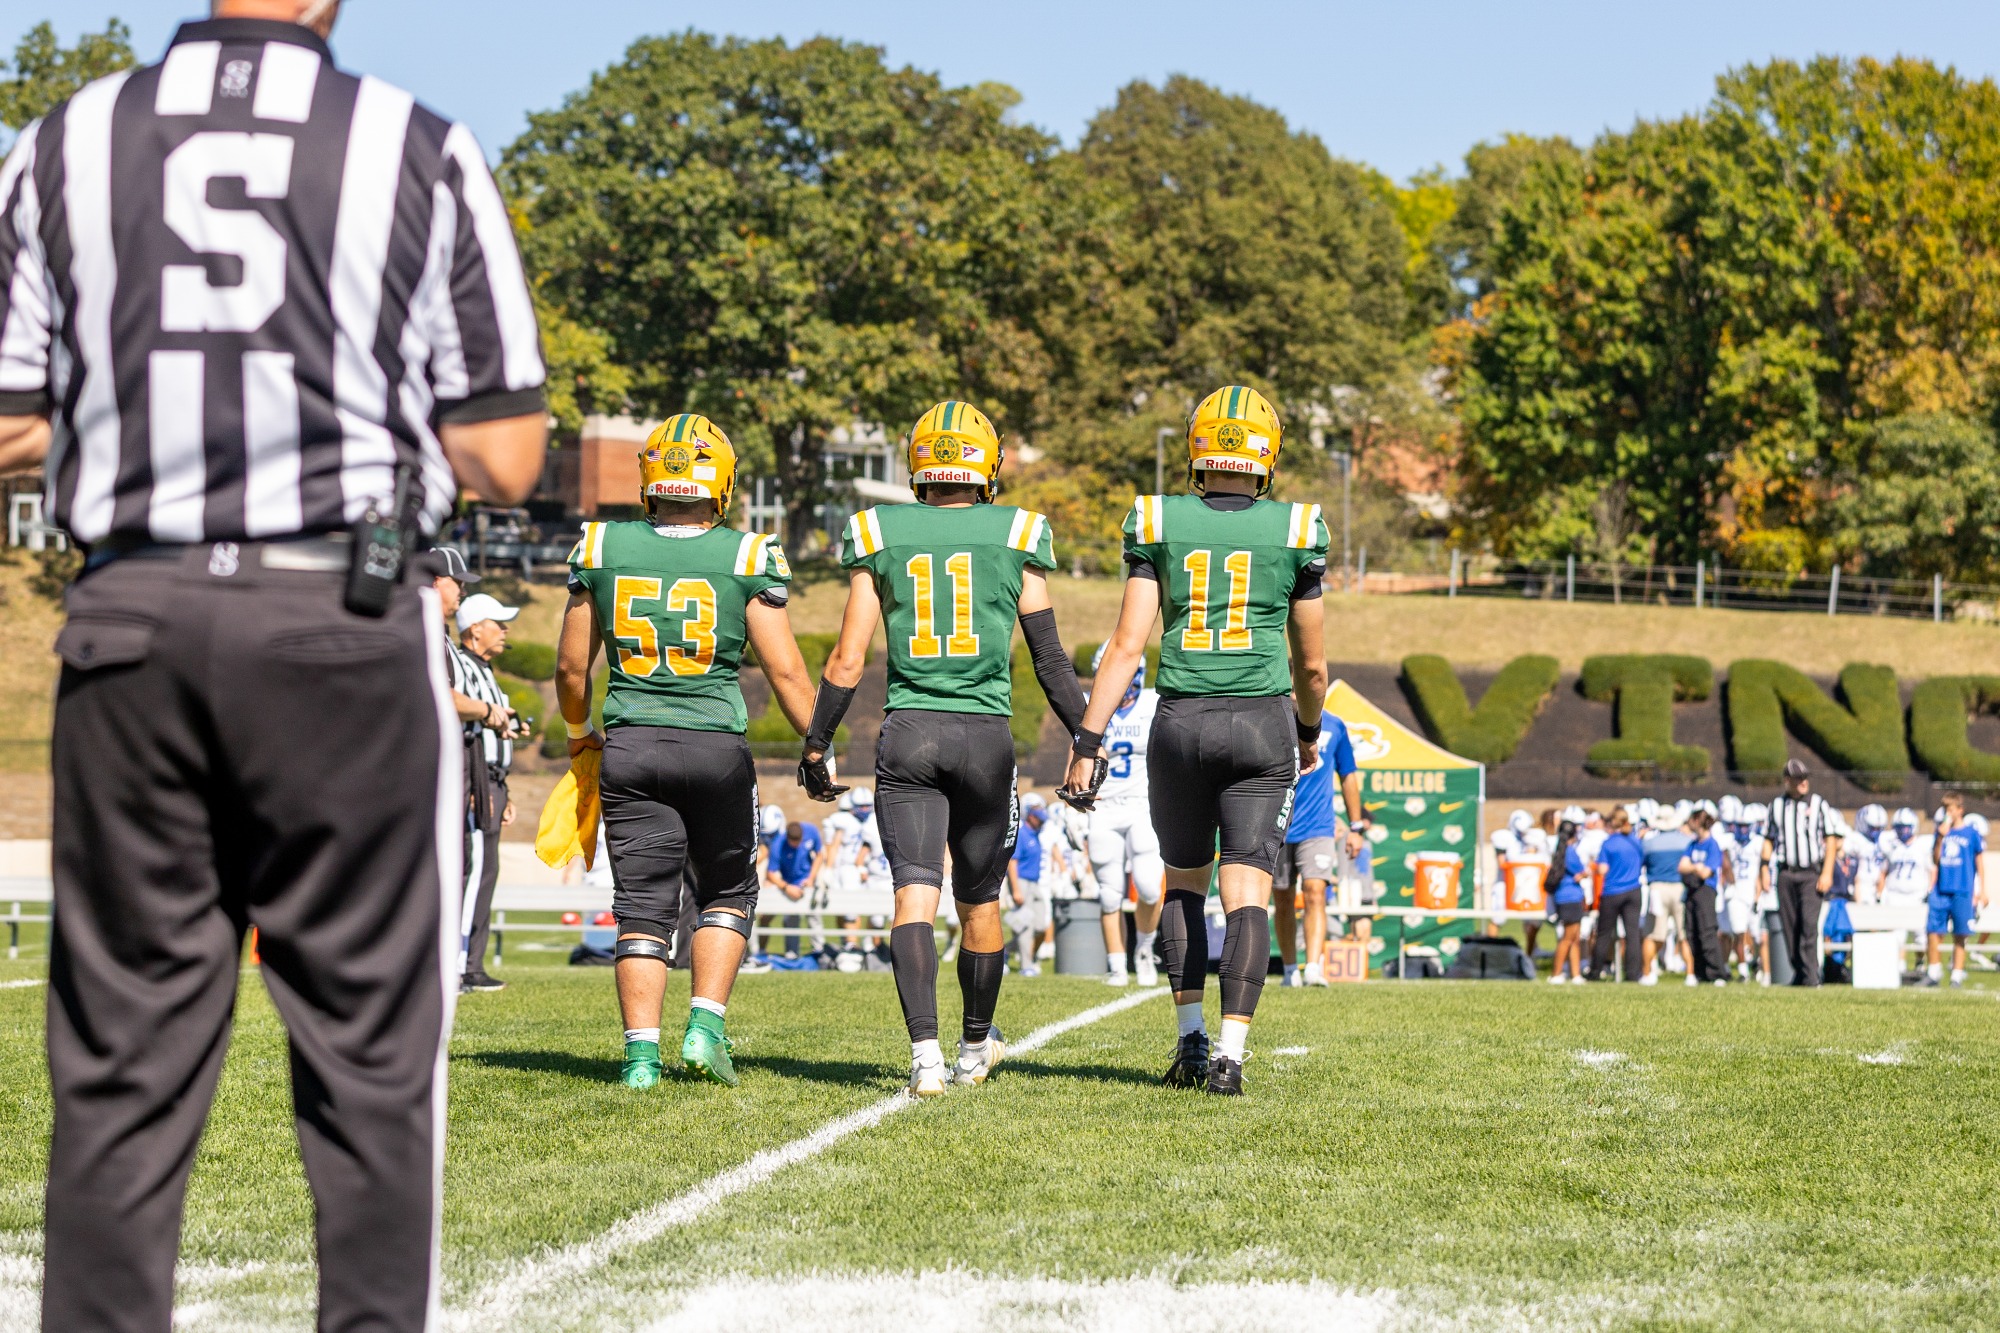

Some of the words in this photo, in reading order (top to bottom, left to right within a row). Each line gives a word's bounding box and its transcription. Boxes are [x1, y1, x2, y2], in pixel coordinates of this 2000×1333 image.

[161, 132, 295, 333] S
[924, 471, 971, 482] Riddell
[1205, 459, 1253, 473] Riddell
[655, 483, 698, 495] Riddell
[767, 545, 791, 577] 5
[906, 552, 980, 658] 11
[1181, 550, 1253, 651] 11
[613, 575, 718, 677] 53
[1110, 741, 1133, 778] 3
[1371, 771, 1447, 793] COLLEGE
[1328, 947, 1361, 978] 50
